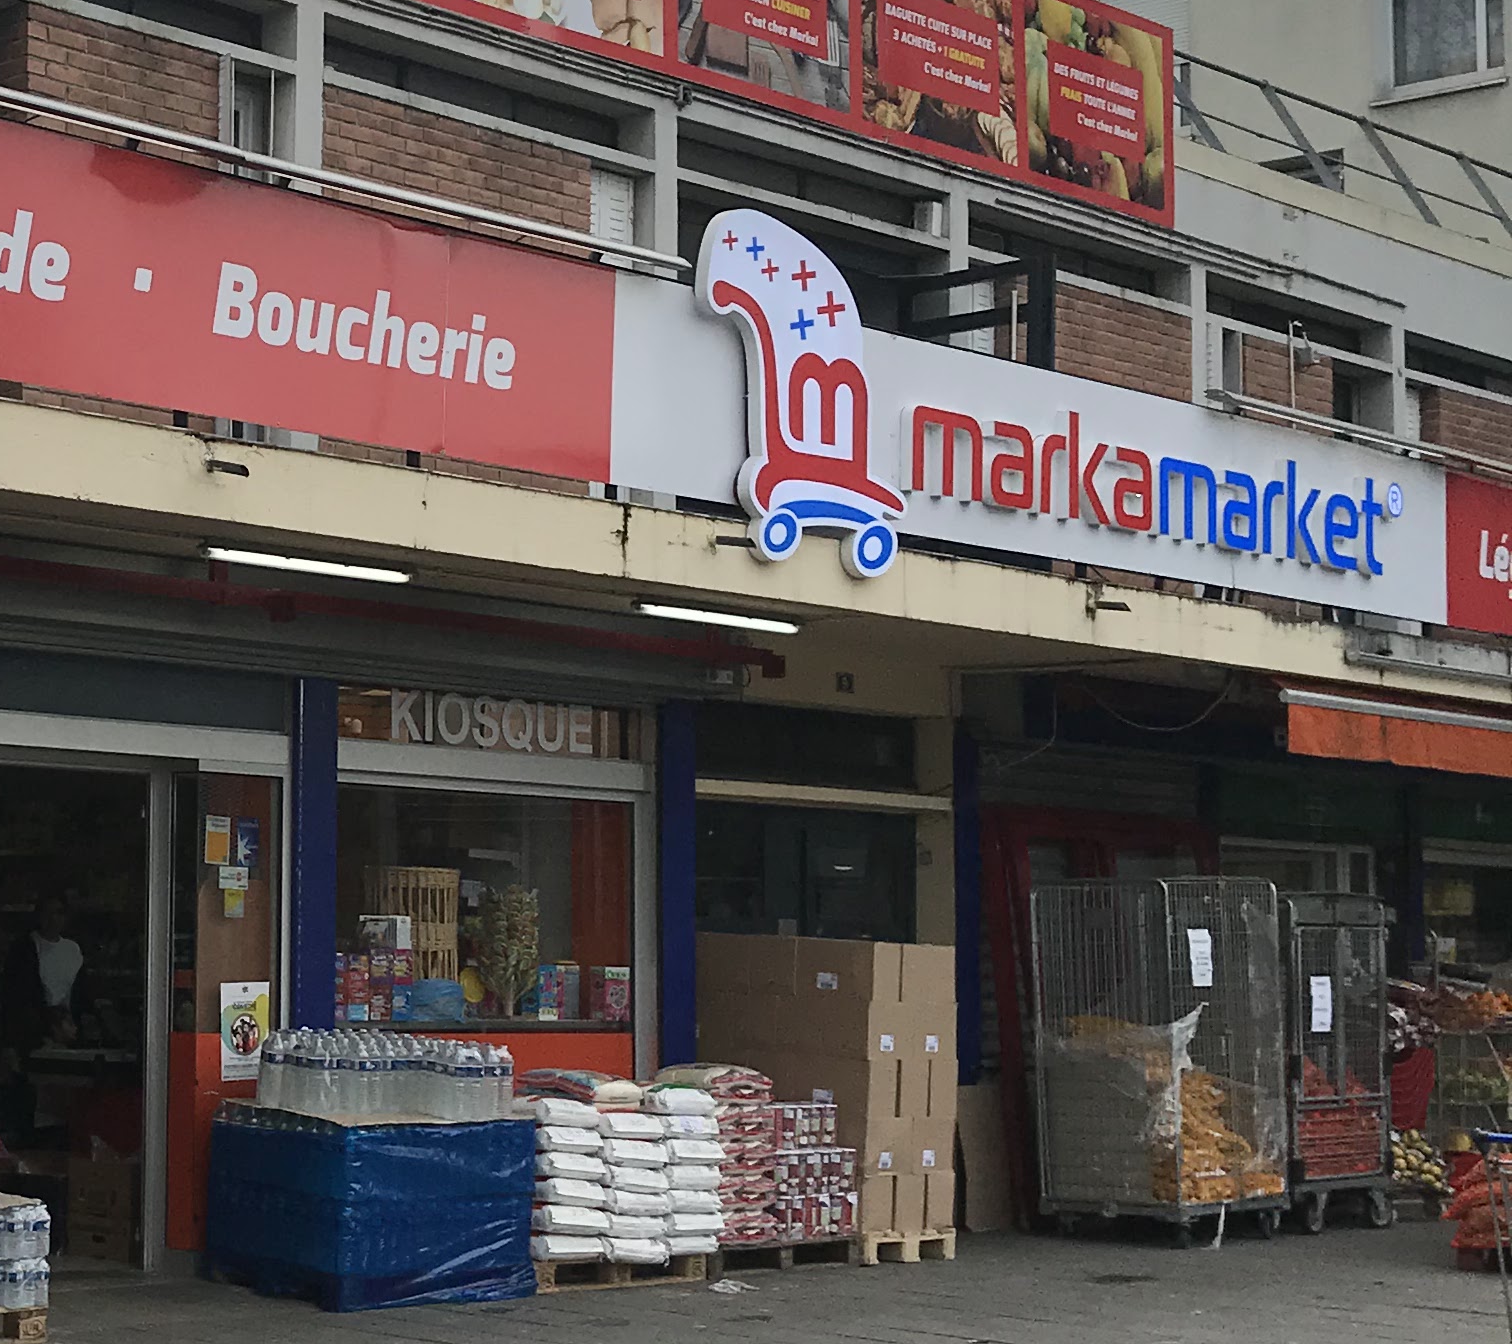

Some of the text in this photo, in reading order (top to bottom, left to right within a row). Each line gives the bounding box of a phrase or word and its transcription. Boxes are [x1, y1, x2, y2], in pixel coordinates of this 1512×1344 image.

[744, 12, 766, 29] C'est
[885, 3, 992, 49] BAGUETTE CUITE SUR PLACE
[893, 29, 899, 40] 3
[1096, 76, 1105, 88] ET
[212, 261, 517, 391] Boucherie
[911, 405, 1383, 575] markamarket
[1480, 530, 1512, 600] Lé
[390, 689, 594, 754] KIOSQUE
